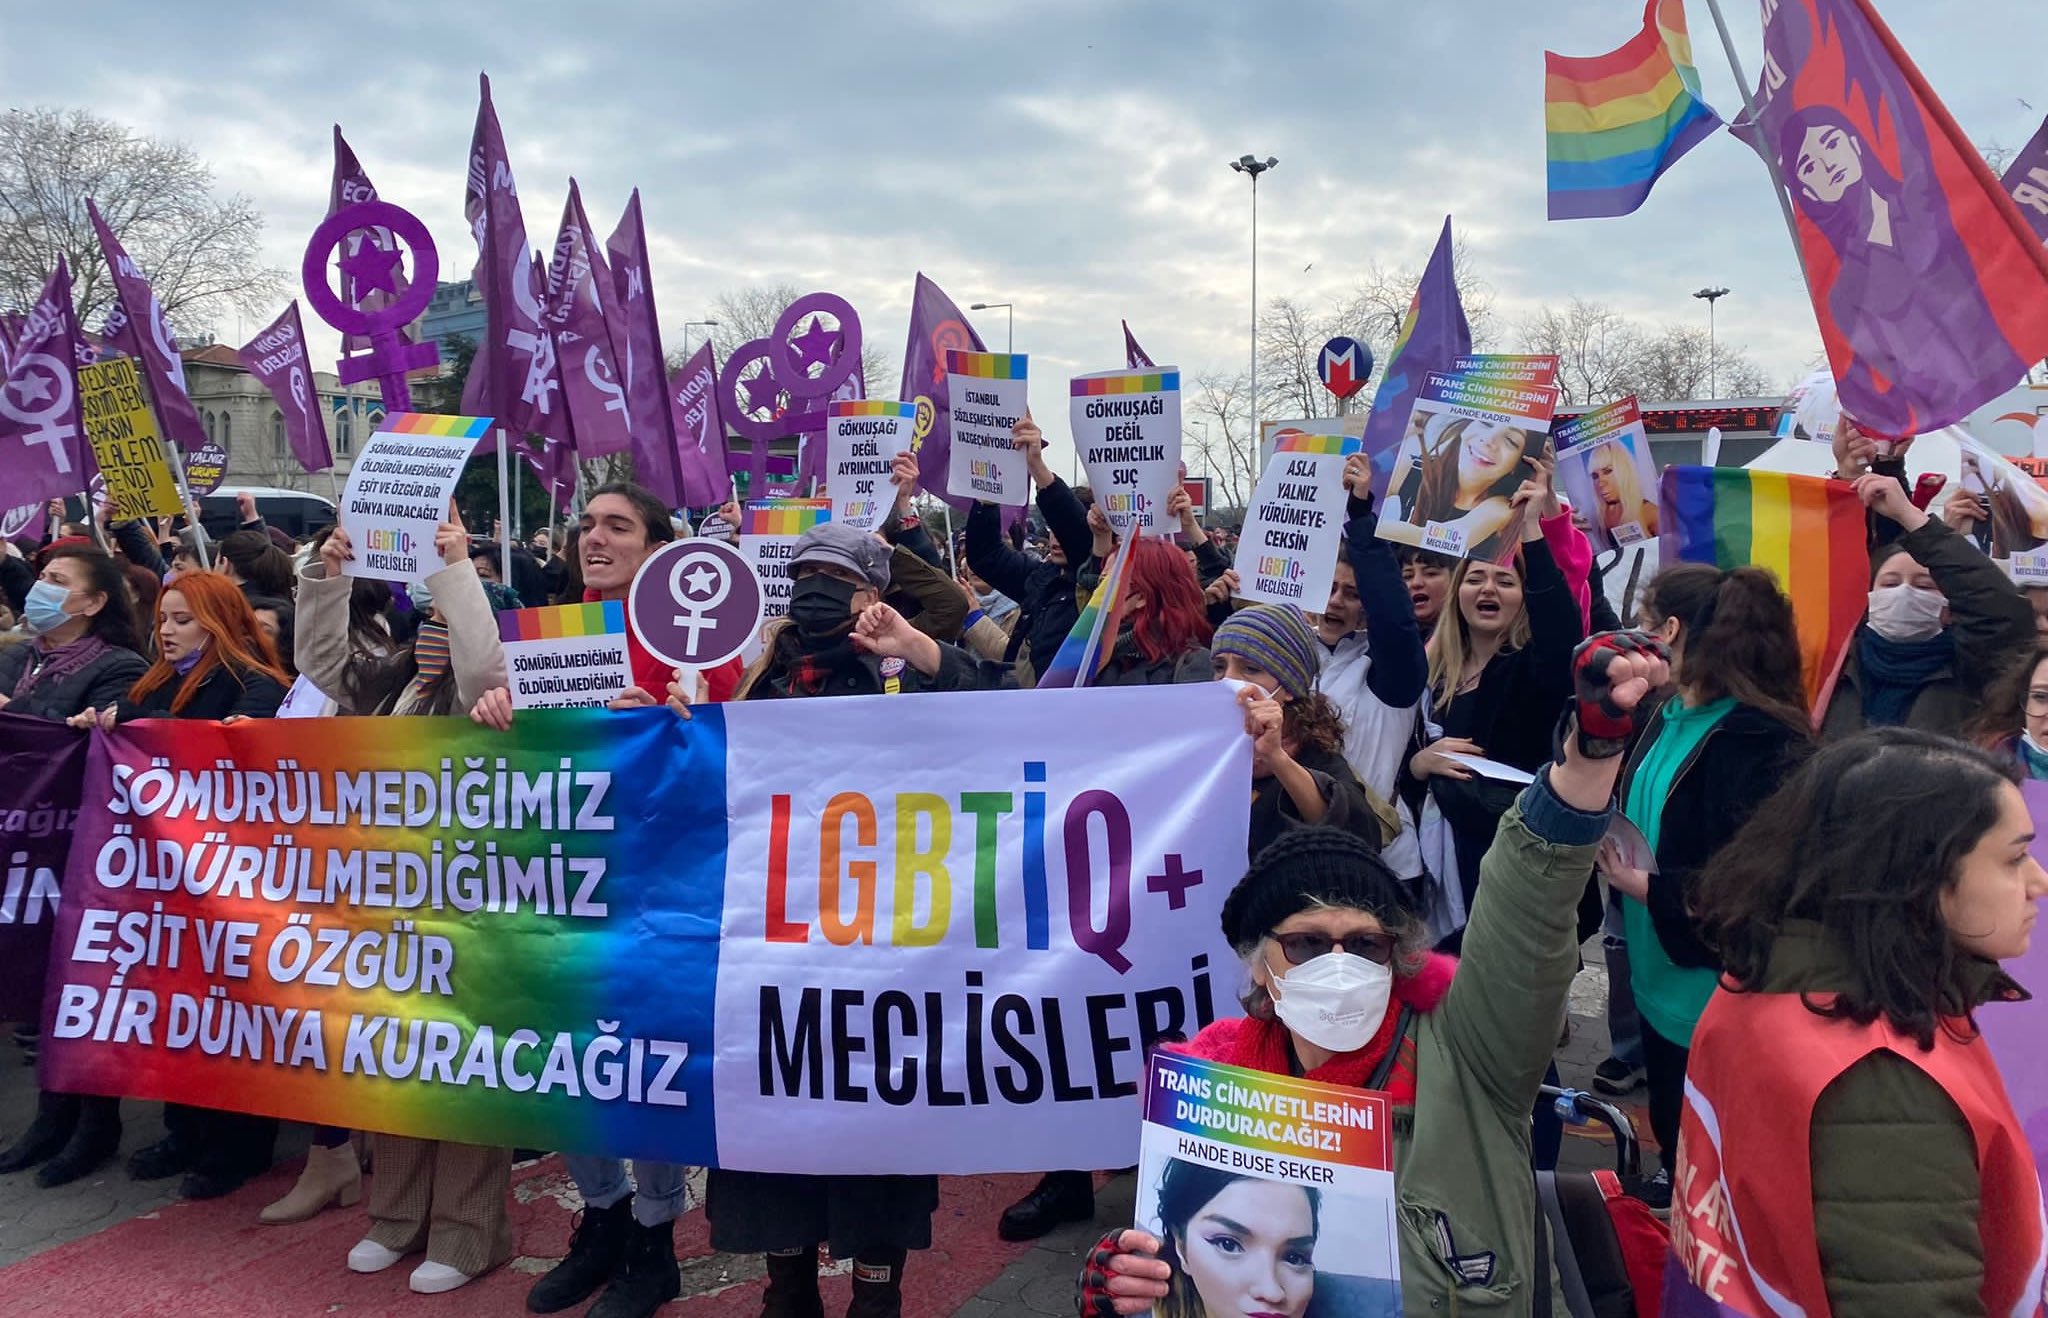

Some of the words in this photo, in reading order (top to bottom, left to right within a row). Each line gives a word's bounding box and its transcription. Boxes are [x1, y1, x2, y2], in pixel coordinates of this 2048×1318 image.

[1456, 360, 1484, 369] TRANS
[965, 388, 1000, 406] İSTANBUL
[1430, 376, 1465, 390] TRANS
[1468, 381, 1549, 404] CİNAYETLERİNİ
[1086, 396, 1163, 420] GÖKKUŞAĞI
[1440, 390, 1530, 412] DURDURACAĞIZ!
[1450, 407, 1480, 419] HANDE
[1482, 411, 1511, 424] KADER
[838, 419, 898, 439] GÖKKUŞAĞI
[1106, 421, 1144, 442] DEĞİL
[369, 442, 466, 460] SÖMÜRÜLMEDİĞİMİZ
[852, 440, 879, 457] DEĞİL
[1088, 445, 1165, 464] AYRIMCILIK
[361, 458, 455, 478] ÖLDÜRÜLMEDİĞİMİZ
[1286, 460, 1317, 477] ASLA
[358, 479, 378, 495] EŞİT
[379, 482, 390, 494] VE
[391, 480, 422, 496] ÖZGÜR
[424, 485, 441, 499] BİR
[855, 480, 874, 497] SUÇ
[1113, 469, 1138, 489] SUÇ
[1104, 491, 1153, 513] LGBTİQ+
[1276, 482, 1318, 502] YALNIZ
[352, 498, 382, 515] DÜNYA
[384, 503, 439, 520] KURACAĞIZ
[1109, 512, 1153, 527] MECLİERİ
[1258, 502, 1327, 528] YÜRÜMEYE-
[367, 528, 417, 553] LGBTİQ+
[760, 542, 778, 559] BİZİ
[780, 545, 793, 559] EZ
[1265, 530, 1309, 551] CEKSİN
[367, 553, 417, 573] MECLİSLERİ
[757, 564, 770, 578] BU
[772, 561, 789, 578] DÜ
[1258, 556, 1306, 582] LGBTİQ+
[1255, 577, 1303, 598] MECLİSLERİ
[514, 648, 624, 672] SÖMÜRÜLMEDİĞİMİZ
[519, 672, 626, 695] ÖLDÜRÜLMEDİĞİMİZ
[106, 756, 615, 831] SÖMÜRÜLMEDİĞİMİZ
[94, 825, 608, 918] ÖLDÜRÜLMEDİĞİMİZ
[764, 761, 1203, 976] LGBTİQ+
[71, 901, 187, 976] EŞİT
[197, 919, 259, 978] VE
[266, 912, 454, 996] ÖZGÜR
[758, 953, 1215, 1107] MECLİSLERİ
[53, 974, 157, 1045] BİR
[165, 985, 327, 1071] DÜNYA
[341, 1013, 690, 1108] KURACAĞIZ
[1158, 1067, 1211, 1098] TRANS
[1216, 1081, 1374, 1130] CİNAYETLERİNİ
[1176, 1101, 1342, 1153] DURDURACAĞIZ!
[1178, 1137, 1229, 1164] HANDE
[1232, 1151, 1275, 1174] BUSE
[1278, 1160, 1335, 1185] ŞEKER
